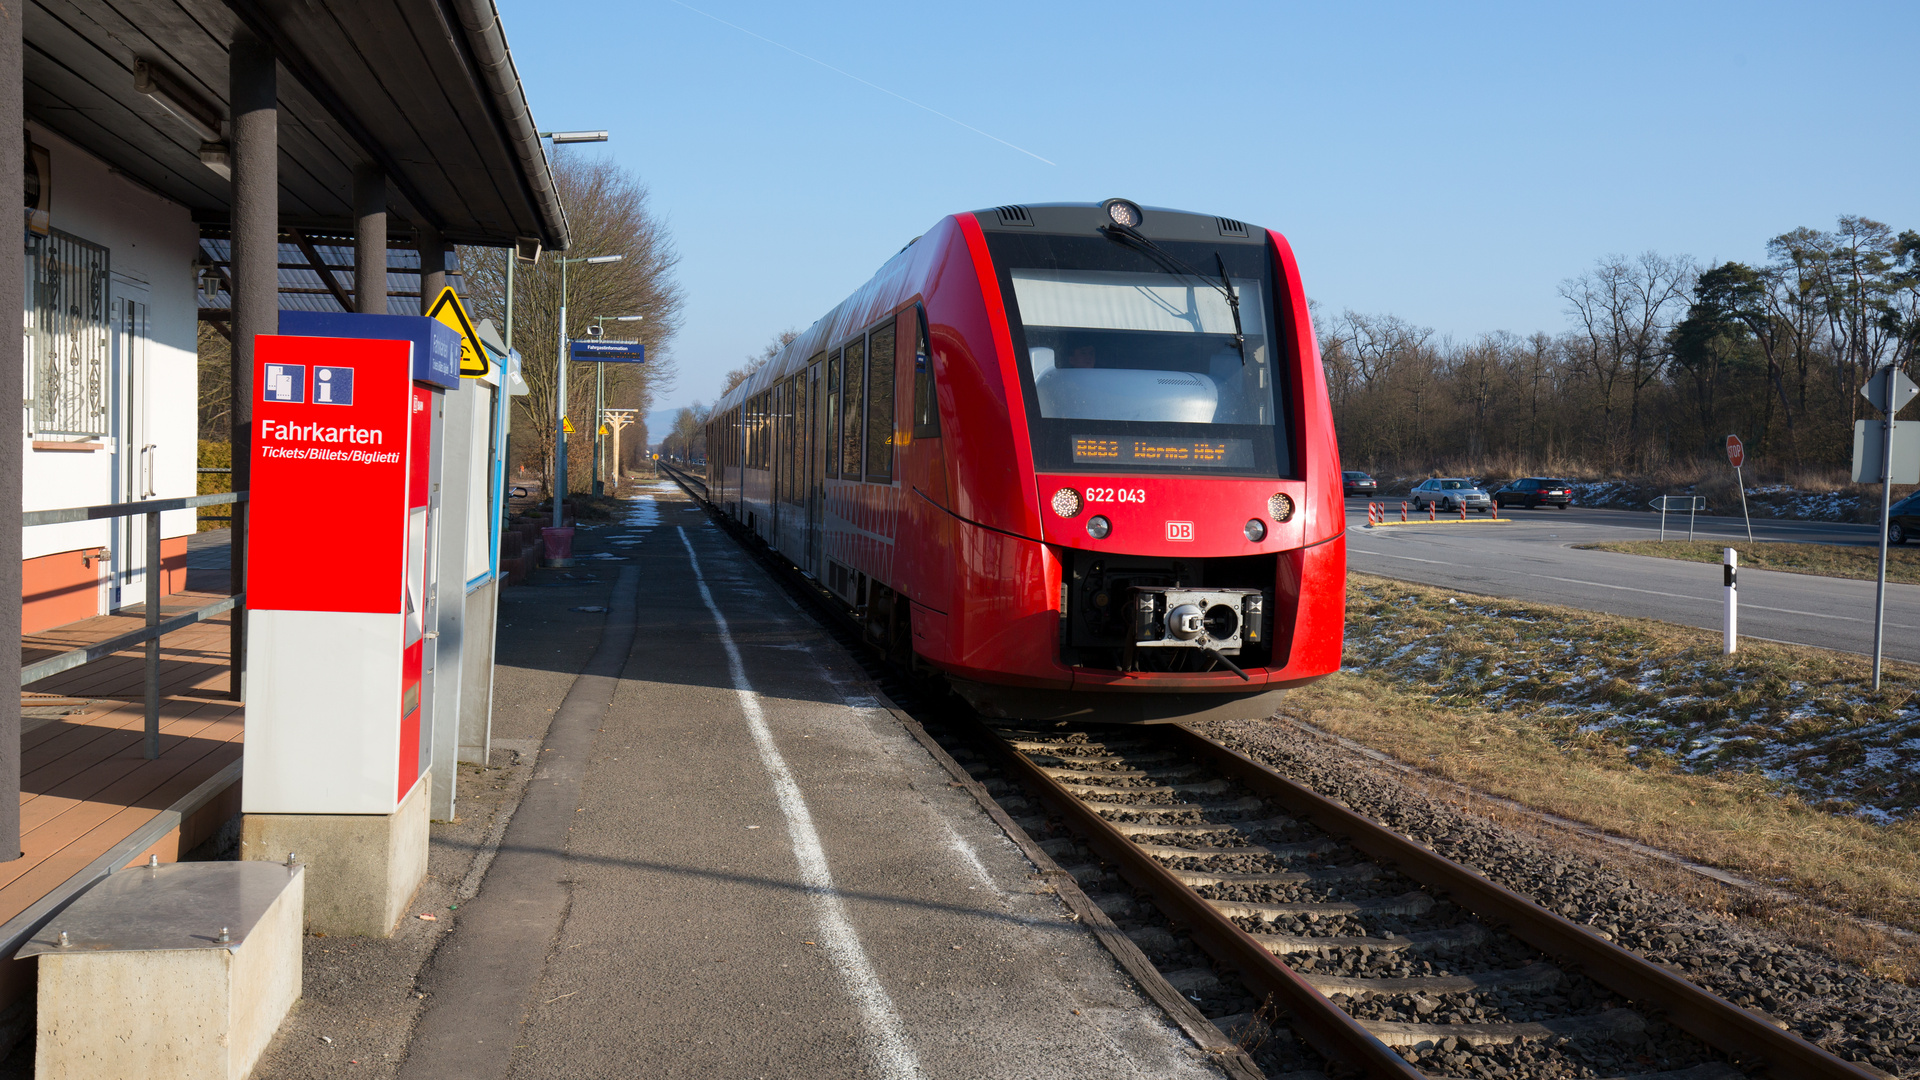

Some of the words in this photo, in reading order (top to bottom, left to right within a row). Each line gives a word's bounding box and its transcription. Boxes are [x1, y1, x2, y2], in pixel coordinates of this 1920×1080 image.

[262, 419, 383, 445] Fahrkarten
[262, 446, 400, 465] Tickets/Billets/Biglietti
[1134, 442, 1188, 459] Worms
[1194, 444, 1225, 460] Hbf
[1728, 444, 1741, 458] STOP
[1086, 487, 1115, 502] 622
[1118, 488, 1146, 503] 043
[1170, 524, 1191, 538] DB
